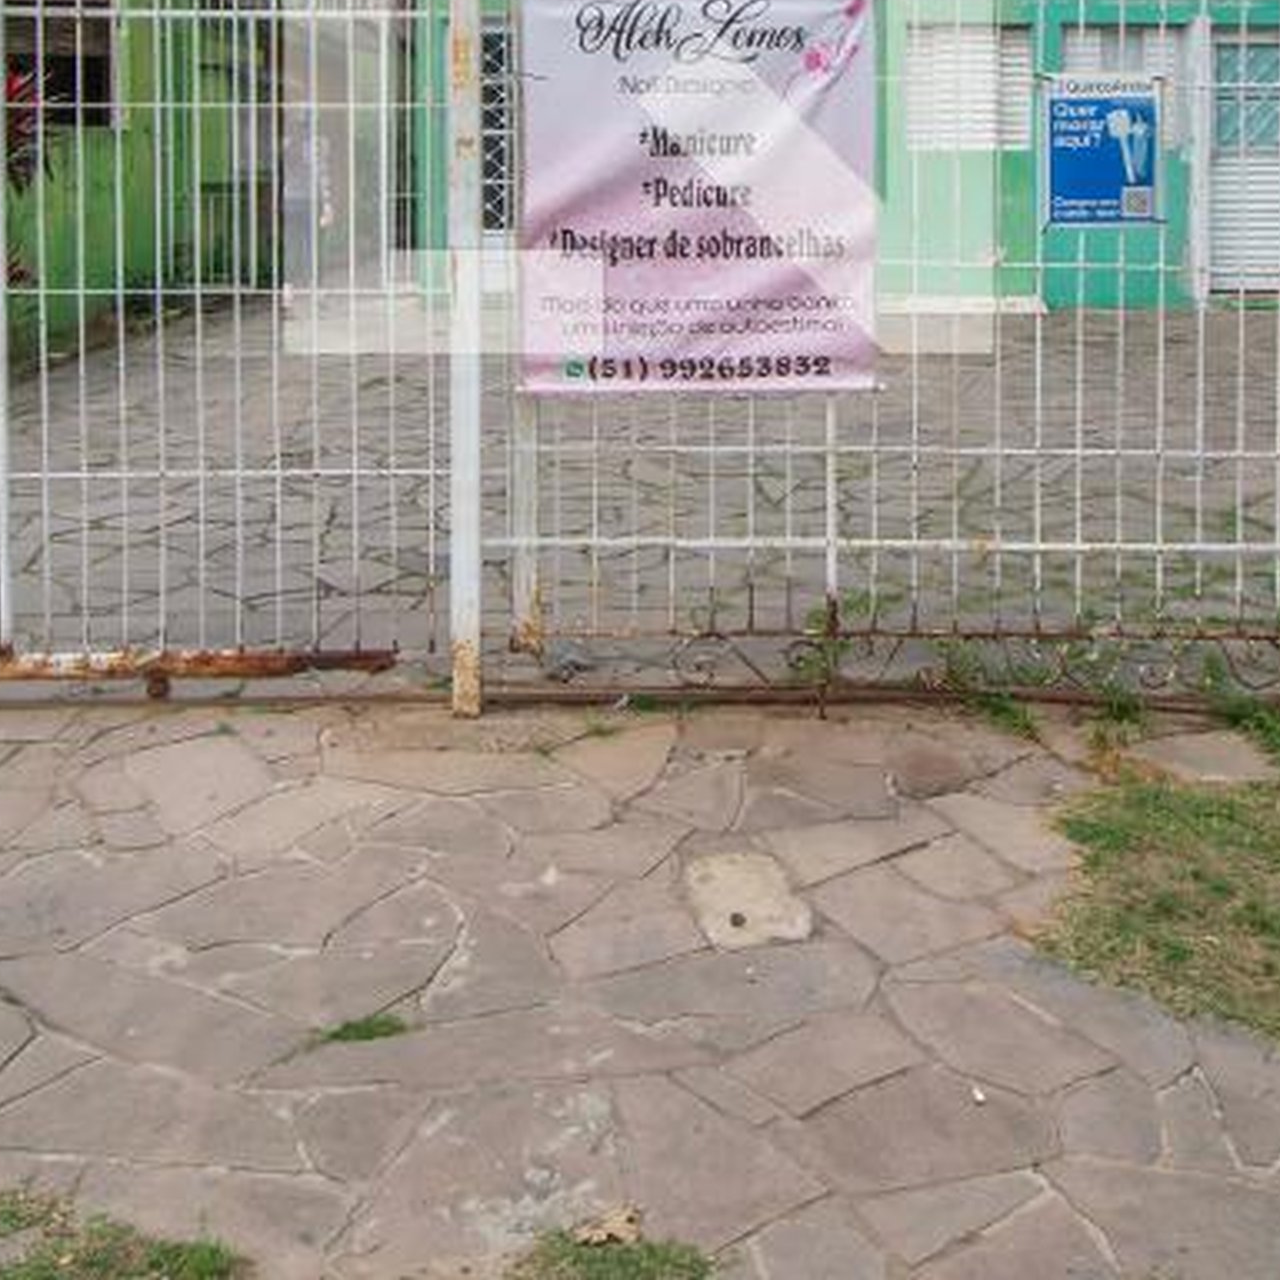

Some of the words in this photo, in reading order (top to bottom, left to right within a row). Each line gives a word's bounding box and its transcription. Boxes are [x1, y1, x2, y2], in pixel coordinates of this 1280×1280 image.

[662, 228, 693, 259] de
[695, 228, 846, 260] sobrancelhas
[588, 356, 649, 381] (51)
[658, 354, 833, 381] 992653832
